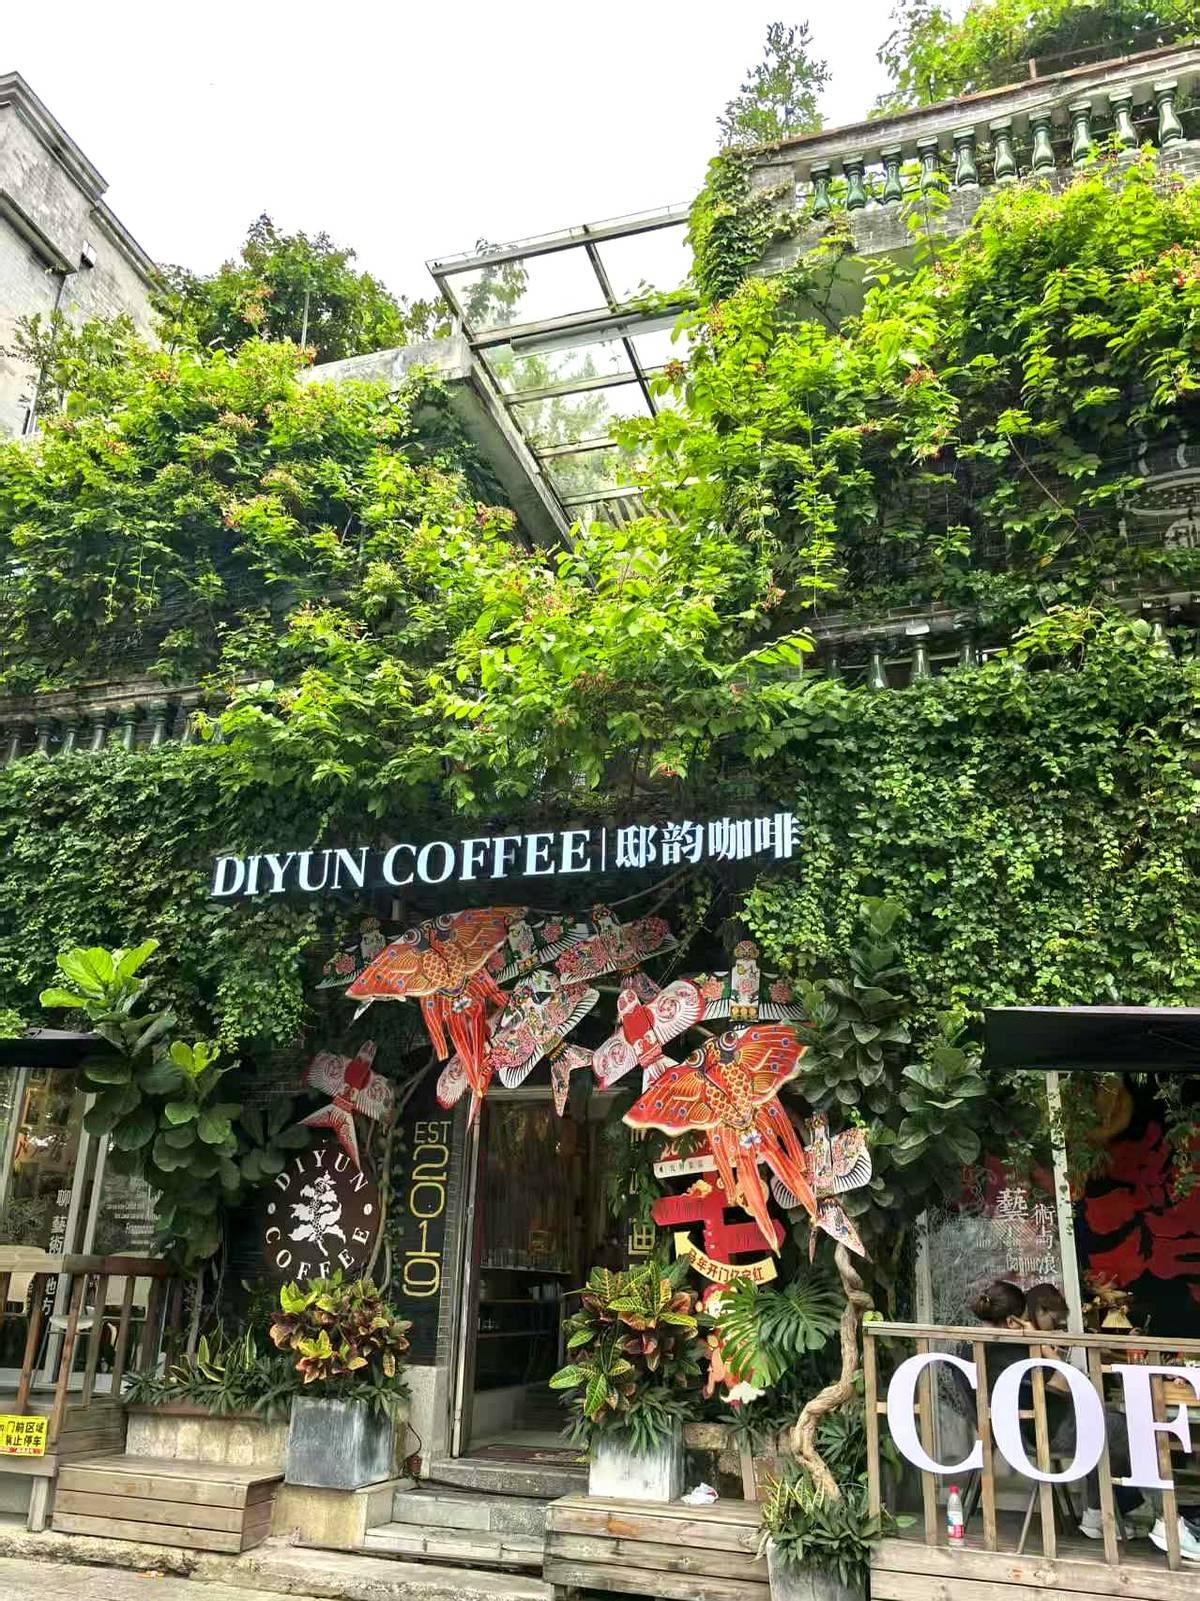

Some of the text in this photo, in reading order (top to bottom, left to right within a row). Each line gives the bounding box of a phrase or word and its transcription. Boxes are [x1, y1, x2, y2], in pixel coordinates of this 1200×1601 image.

[211, 829, 591, 897] DIYUN COFFEE
[615, 812, 801, 869] 邸韵咖啡
[414, 1121, 452, 1144] EST
[274, 1149, 369, 1194] DIYUN
[402, 1144, 450, 1297] 2019
[265, 1226, 370, 1281] COFFEE
[886, 1352, 1200, 1489] COF
